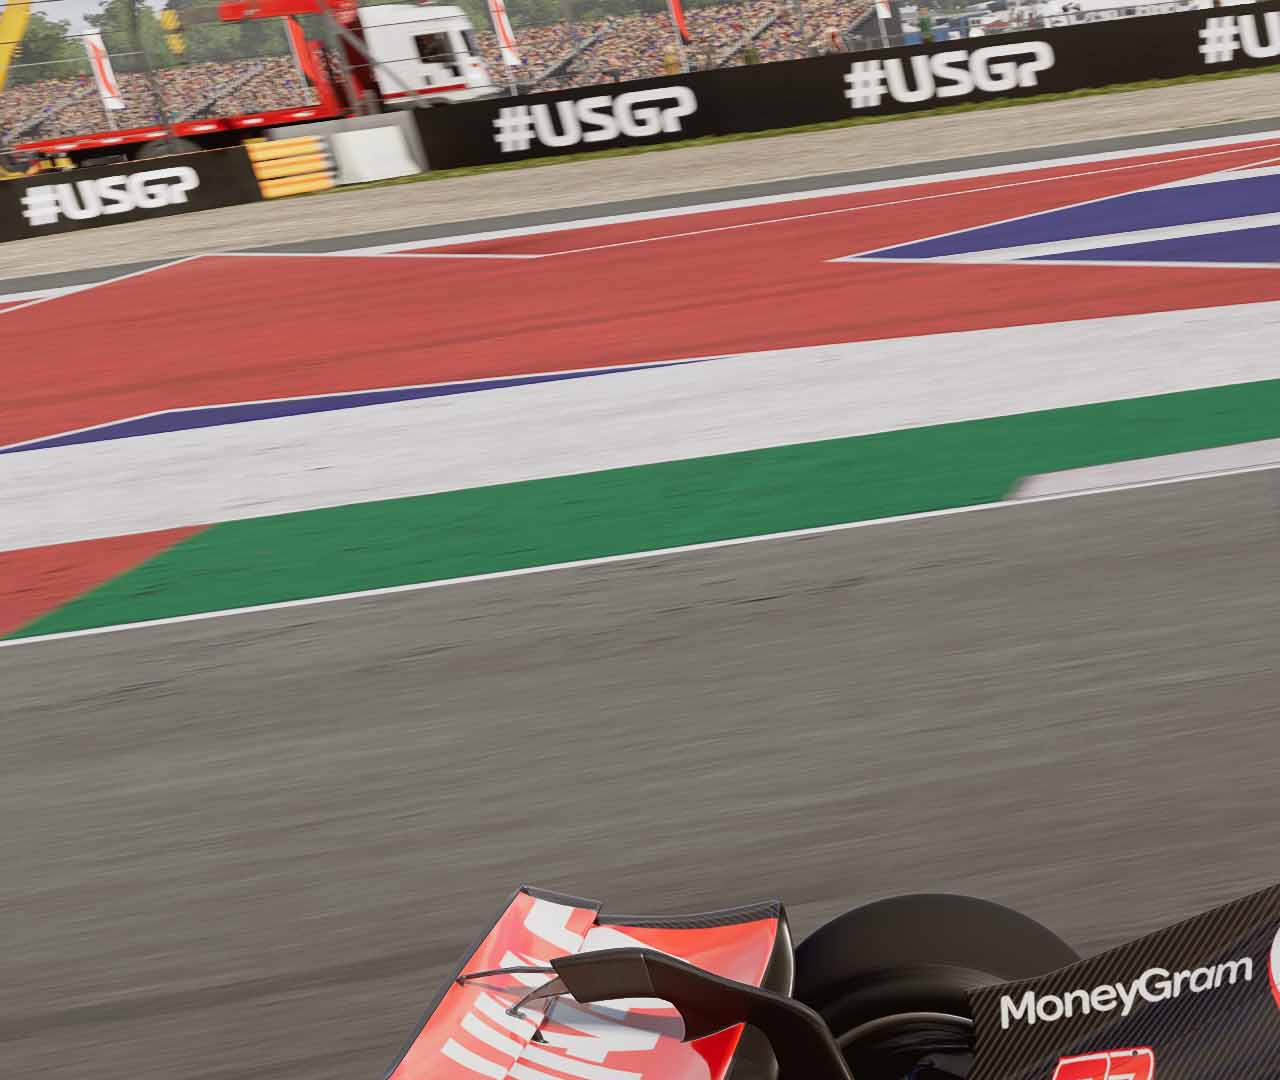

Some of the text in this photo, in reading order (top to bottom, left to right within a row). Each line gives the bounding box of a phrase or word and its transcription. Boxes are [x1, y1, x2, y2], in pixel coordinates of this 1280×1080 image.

[845, 40, 1055, 110] #USGP
[493, 85, 698, 153] #USGP
[21, 166, 200, 227] #USGP
[1000, 957, 1253, 1030] MoneyGram
